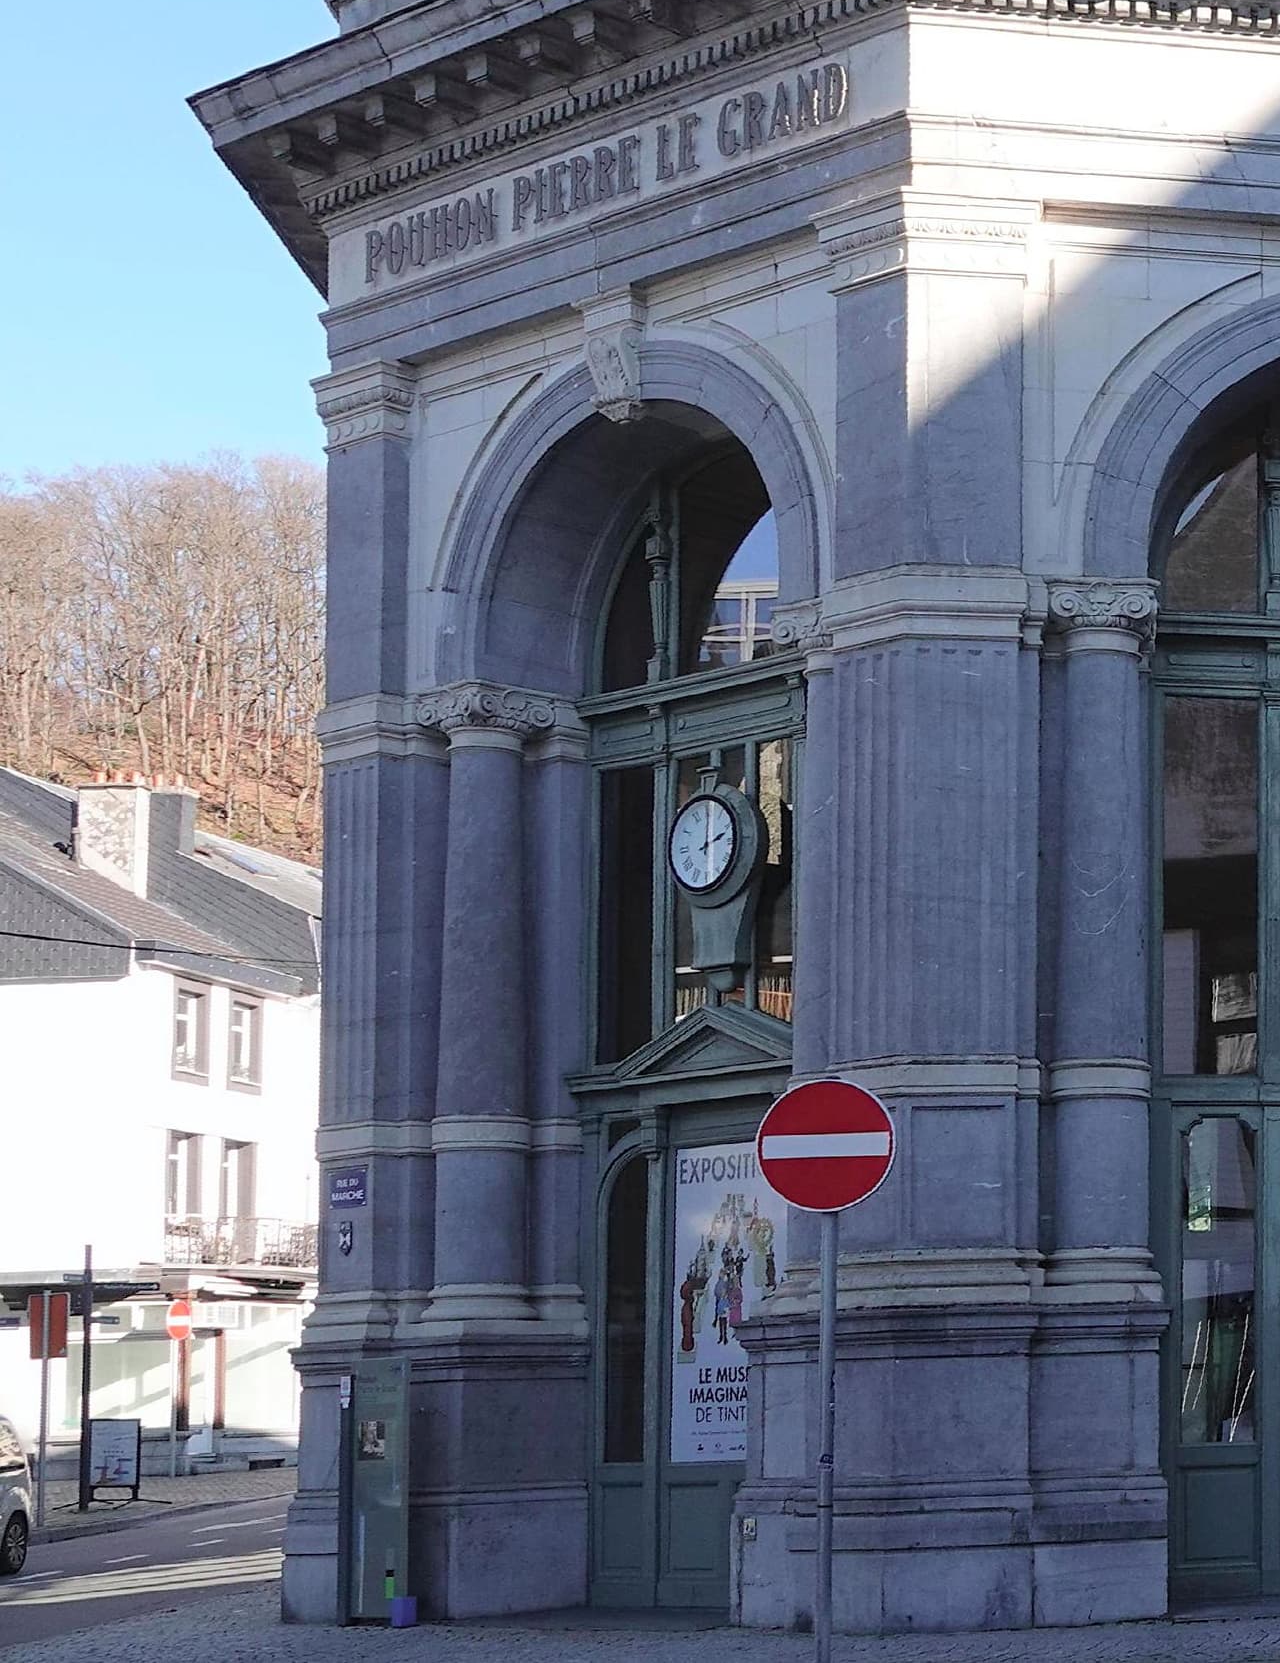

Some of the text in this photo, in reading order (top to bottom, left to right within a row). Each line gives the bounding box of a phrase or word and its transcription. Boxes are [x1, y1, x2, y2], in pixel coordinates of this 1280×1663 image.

[365, 62, 848, 283] POUHON PIERRE LE GRAND
[679, 1152, 758, 1184] EXPOSITI
[699, 1368, 712, 1384] LE
[695, 1407, 712, 1423] DE
